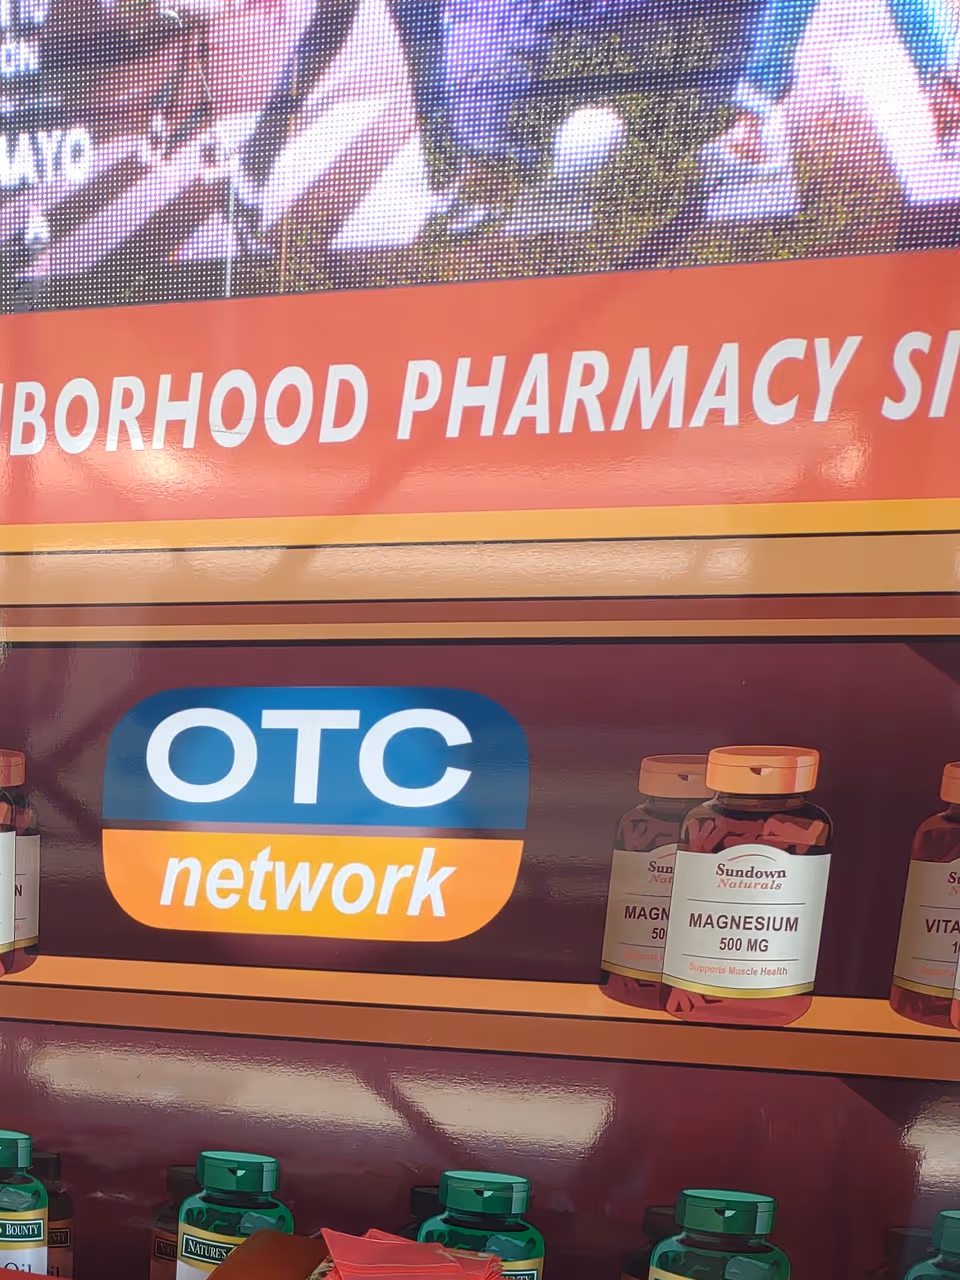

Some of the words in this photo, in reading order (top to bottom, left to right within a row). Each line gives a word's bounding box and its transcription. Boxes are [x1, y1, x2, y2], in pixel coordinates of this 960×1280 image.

[396, 335, 862, 441] PHARMACY
[145, 706, 474, 809] OTC
[715, 862, 787, 879] Sundown
[159, 844, 458, 918] network
[715, 877, 783, 891] Naturals
[688, 912, 800, 932] MAGNESIUM
[718, 937, 743, 952] 500
[745, 938, 770, 953] MG
[688, 961, 726, 976] Supports
[727, 964, 758, 976] Muscle
[759, 965, 788, 977] Health
[5, 1222, 40, 1236] BOUNTY
[187, 1239, 228, 1260] NATURE'S
